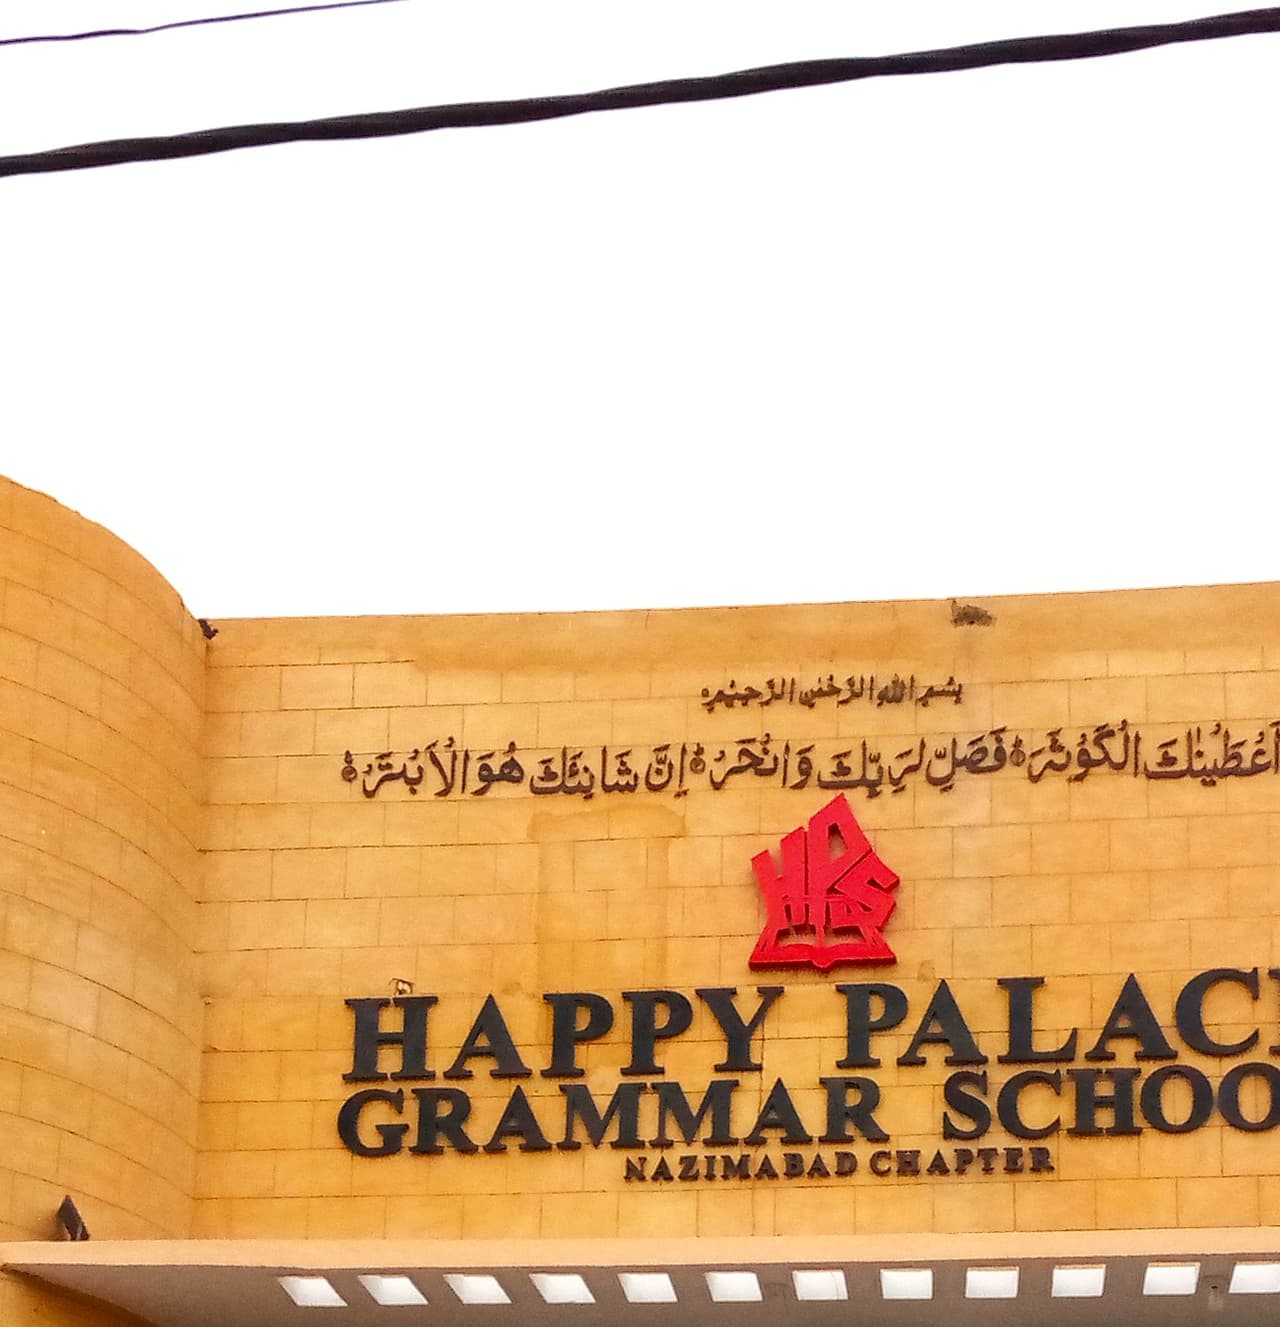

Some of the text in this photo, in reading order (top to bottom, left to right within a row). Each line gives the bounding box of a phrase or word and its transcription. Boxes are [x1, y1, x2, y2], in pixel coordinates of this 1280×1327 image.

[342, 986, 784, 1082] HAPPY
[337, 1076, 891, 1157] GRAMMAR
[624, 1146, 1056, 1182] NAZIMABAD CHAPTER
